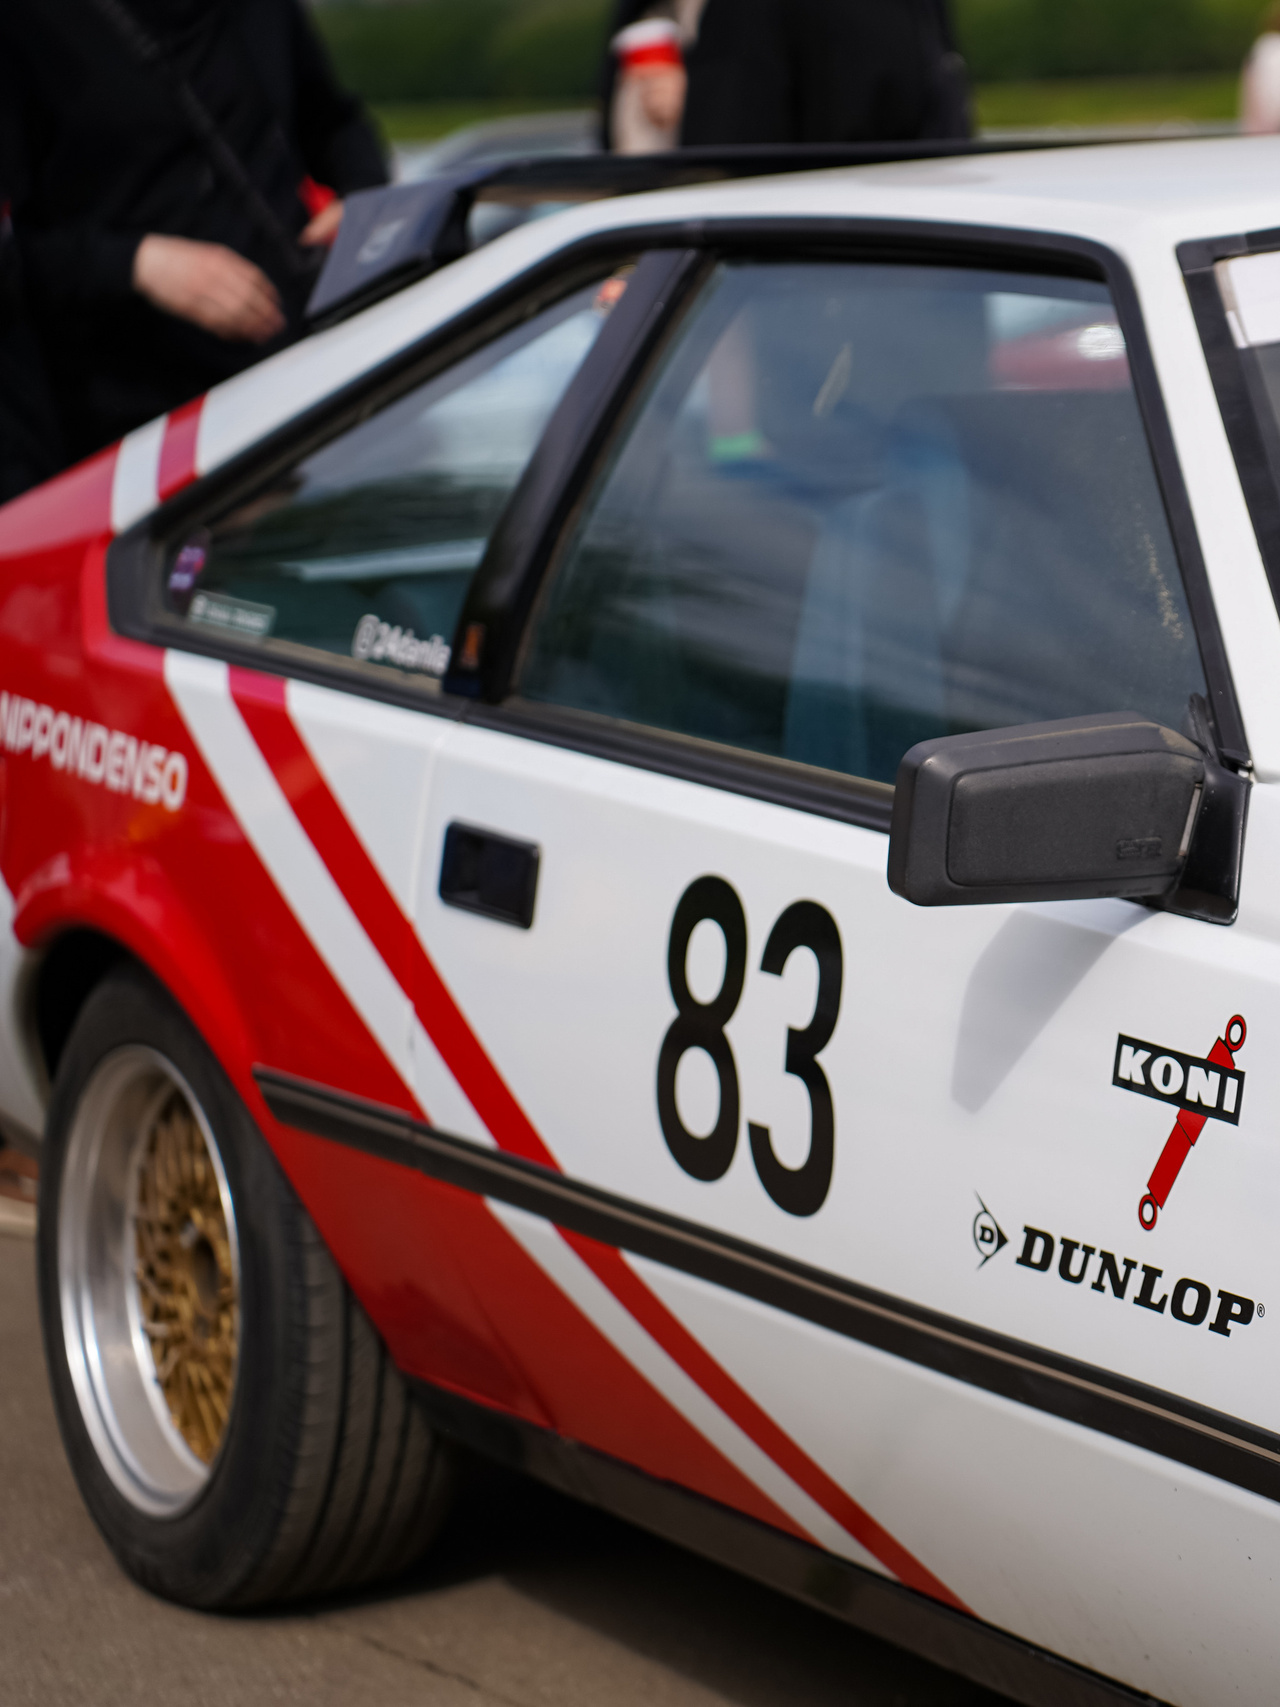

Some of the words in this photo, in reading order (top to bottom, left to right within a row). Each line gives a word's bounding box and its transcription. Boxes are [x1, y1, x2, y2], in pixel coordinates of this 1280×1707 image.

[0, 689, 189, 812] NIPPONDENSO
[656, 871, 844, 1218] 83
[1118, 1043, 1239, 1114] KONI
